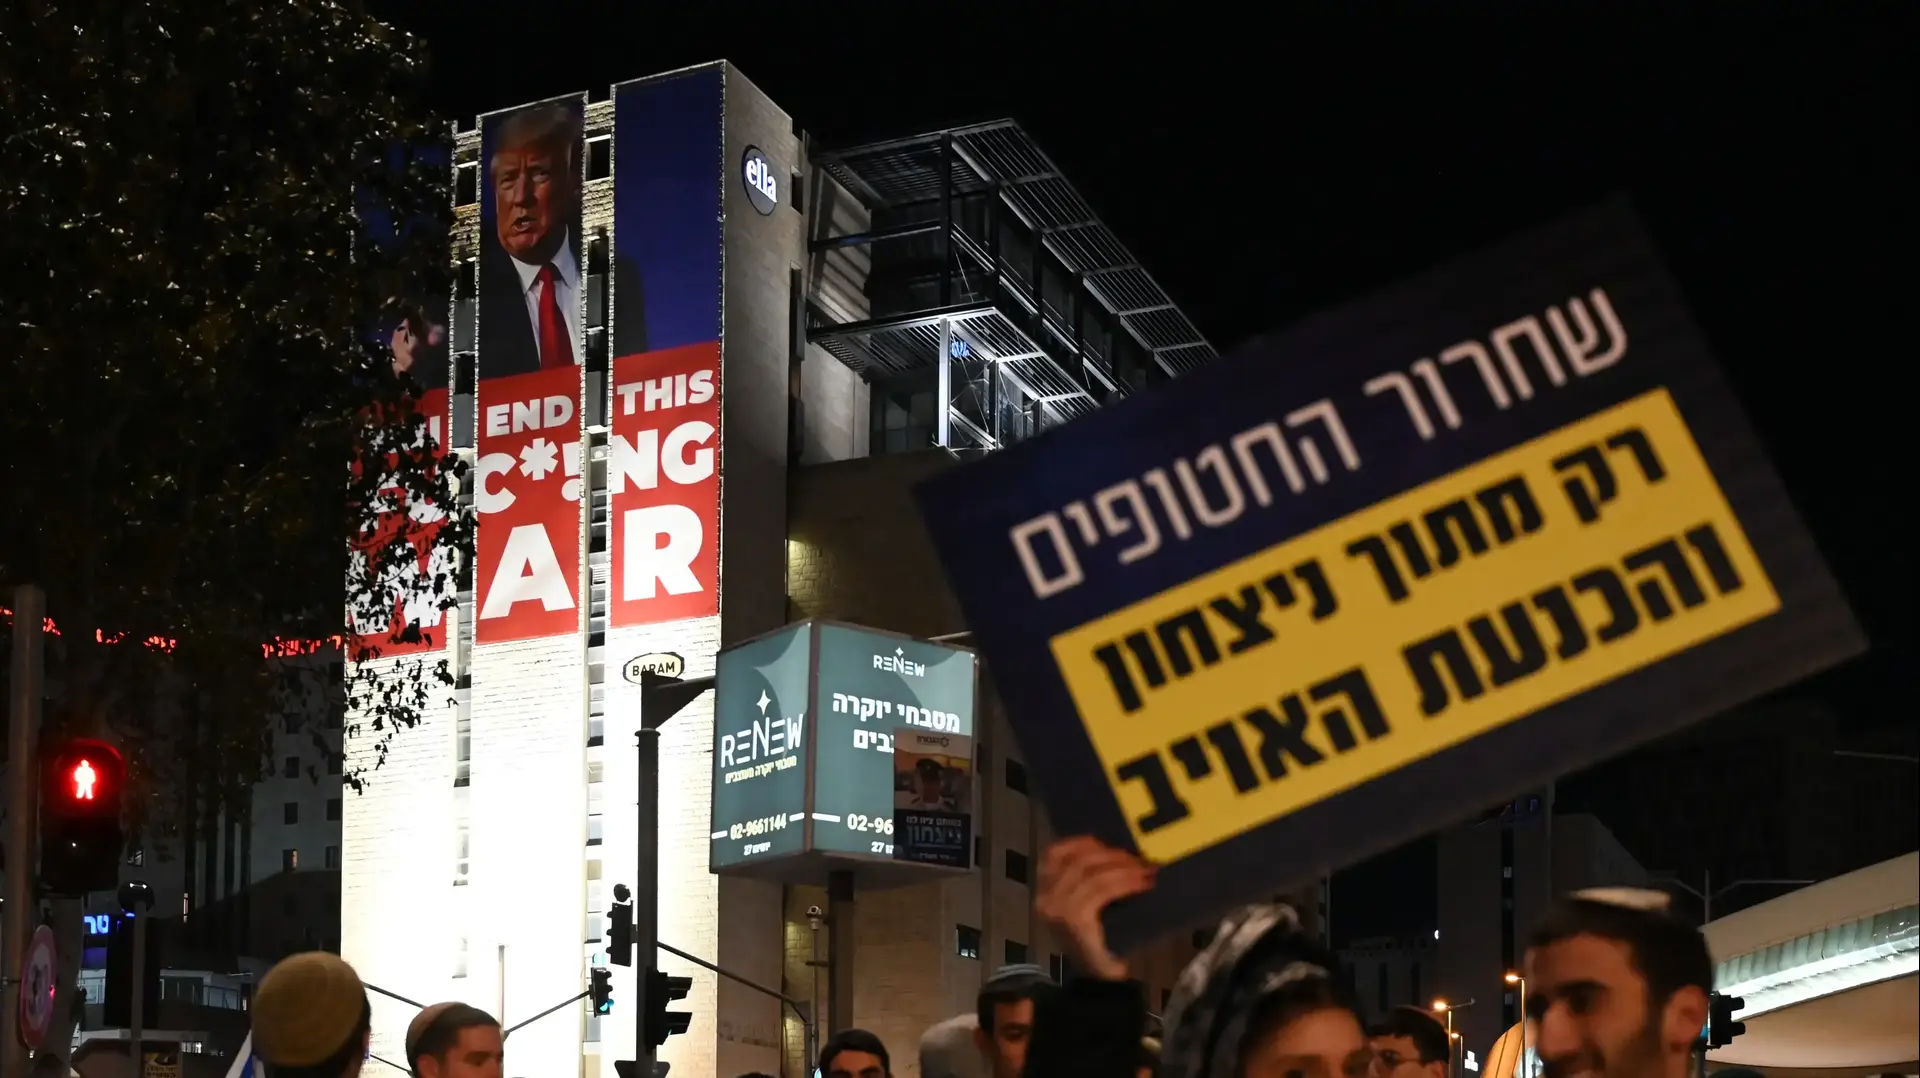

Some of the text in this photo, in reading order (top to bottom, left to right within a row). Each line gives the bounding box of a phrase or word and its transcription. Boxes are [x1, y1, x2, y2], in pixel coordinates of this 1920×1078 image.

[746, 157, 777, 203] ella
[486, 395, 574, 437] END
[617, 369, 715, 416] THIS
[1010, 287, 1627, 600] שחרור החטופים
[1091, 424, 1670, 717] רק מתוך ניצחון
[632, 661, 675, 676] BARAM
[873, 654, 925, 677] RENEW
[1115, 520, 1747, 836] והכנעת האויב
[832, 692, 960, 733] מטבחי יוקרה
[720, 713, 804, 768] RENEW
[871, 841, 885, 853] 27
